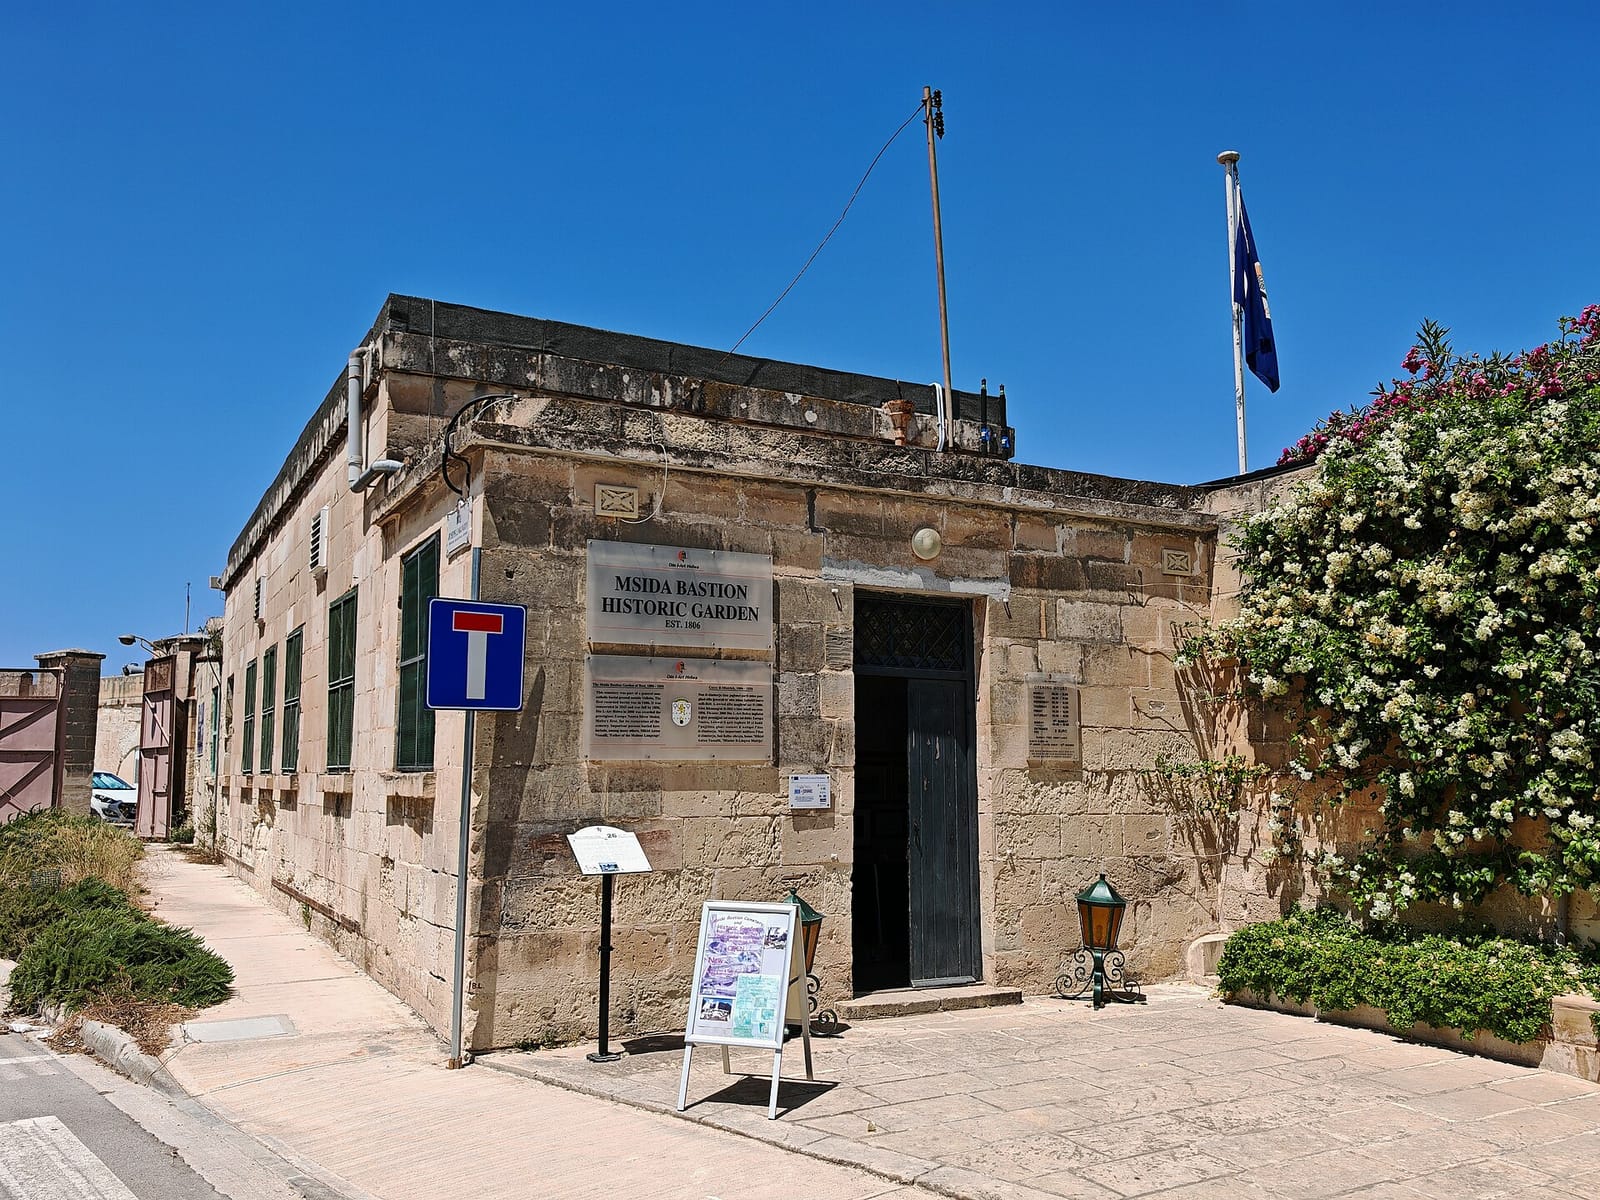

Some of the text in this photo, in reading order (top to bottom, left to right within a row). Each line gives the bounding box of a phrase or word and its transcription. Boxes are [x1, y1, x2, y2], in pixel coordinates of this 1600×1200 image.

[615, 576, 747, 599] MSIDA BASTION
[602, 597, 759, 621] HISTORIC GARDEN
[665, 620, 701, 630] EST. 1806
